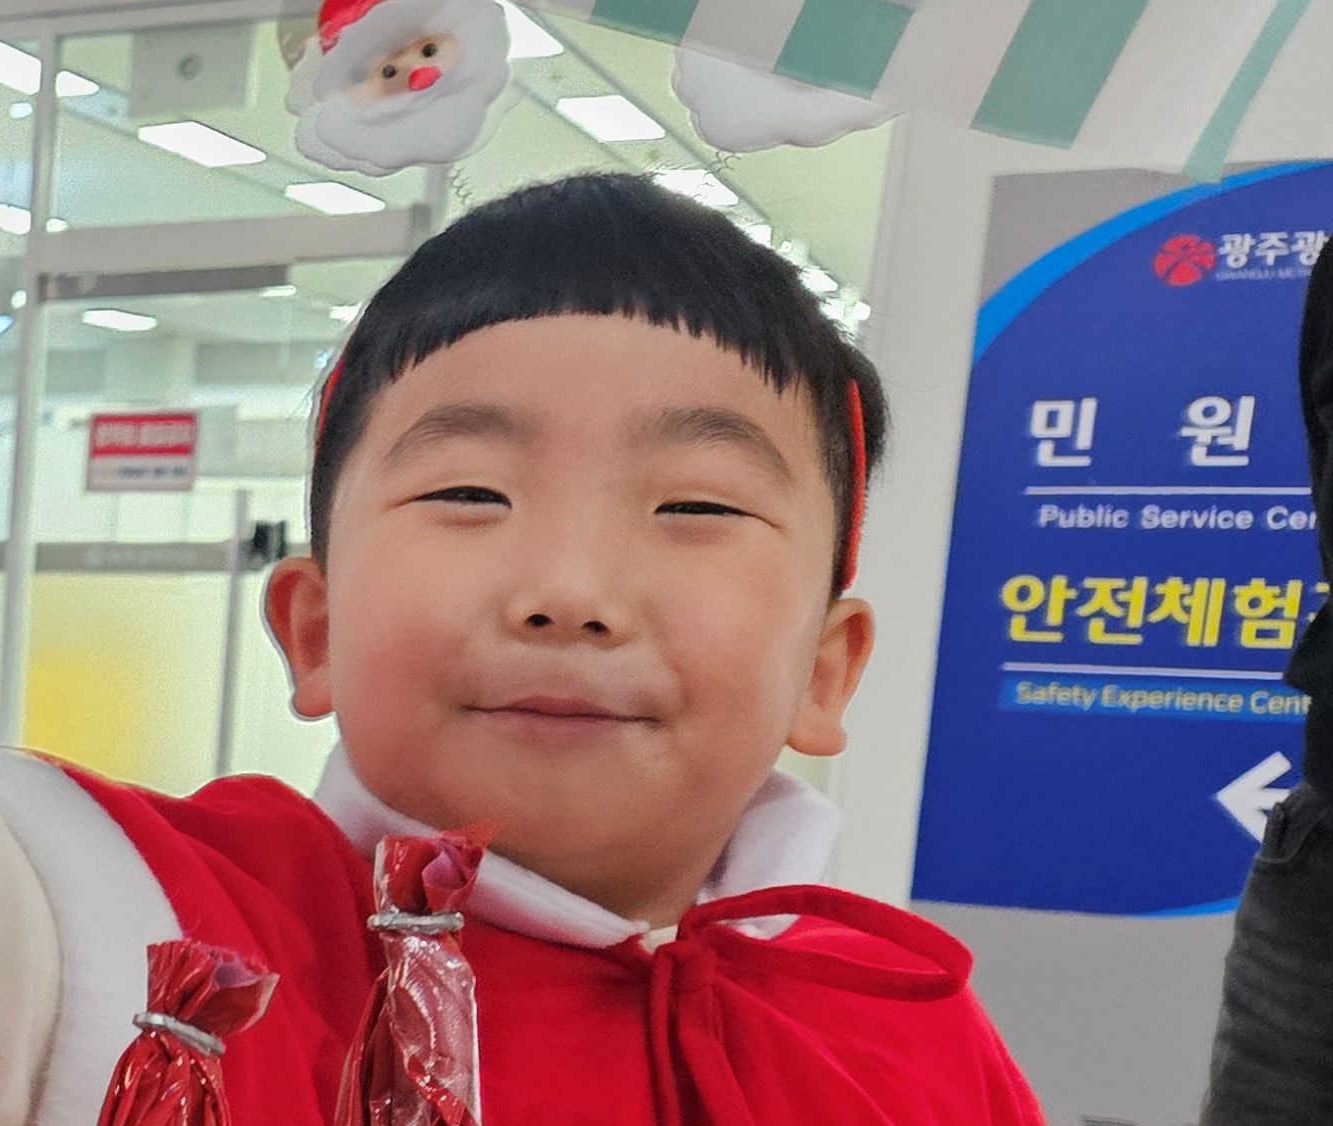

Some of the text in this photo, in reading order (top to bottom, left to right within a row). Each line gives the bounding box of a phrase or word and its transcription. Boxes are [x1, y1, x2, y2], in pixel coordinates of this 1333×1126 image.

[1038, 504, 1129, 529] Public
[1141, 504, 1253, 530] Service
[1000, 574, 1331, 650] 안전체험
[1015, 682, 1097, 710] Safety
[1100, 686, 1244, 713] Experience
